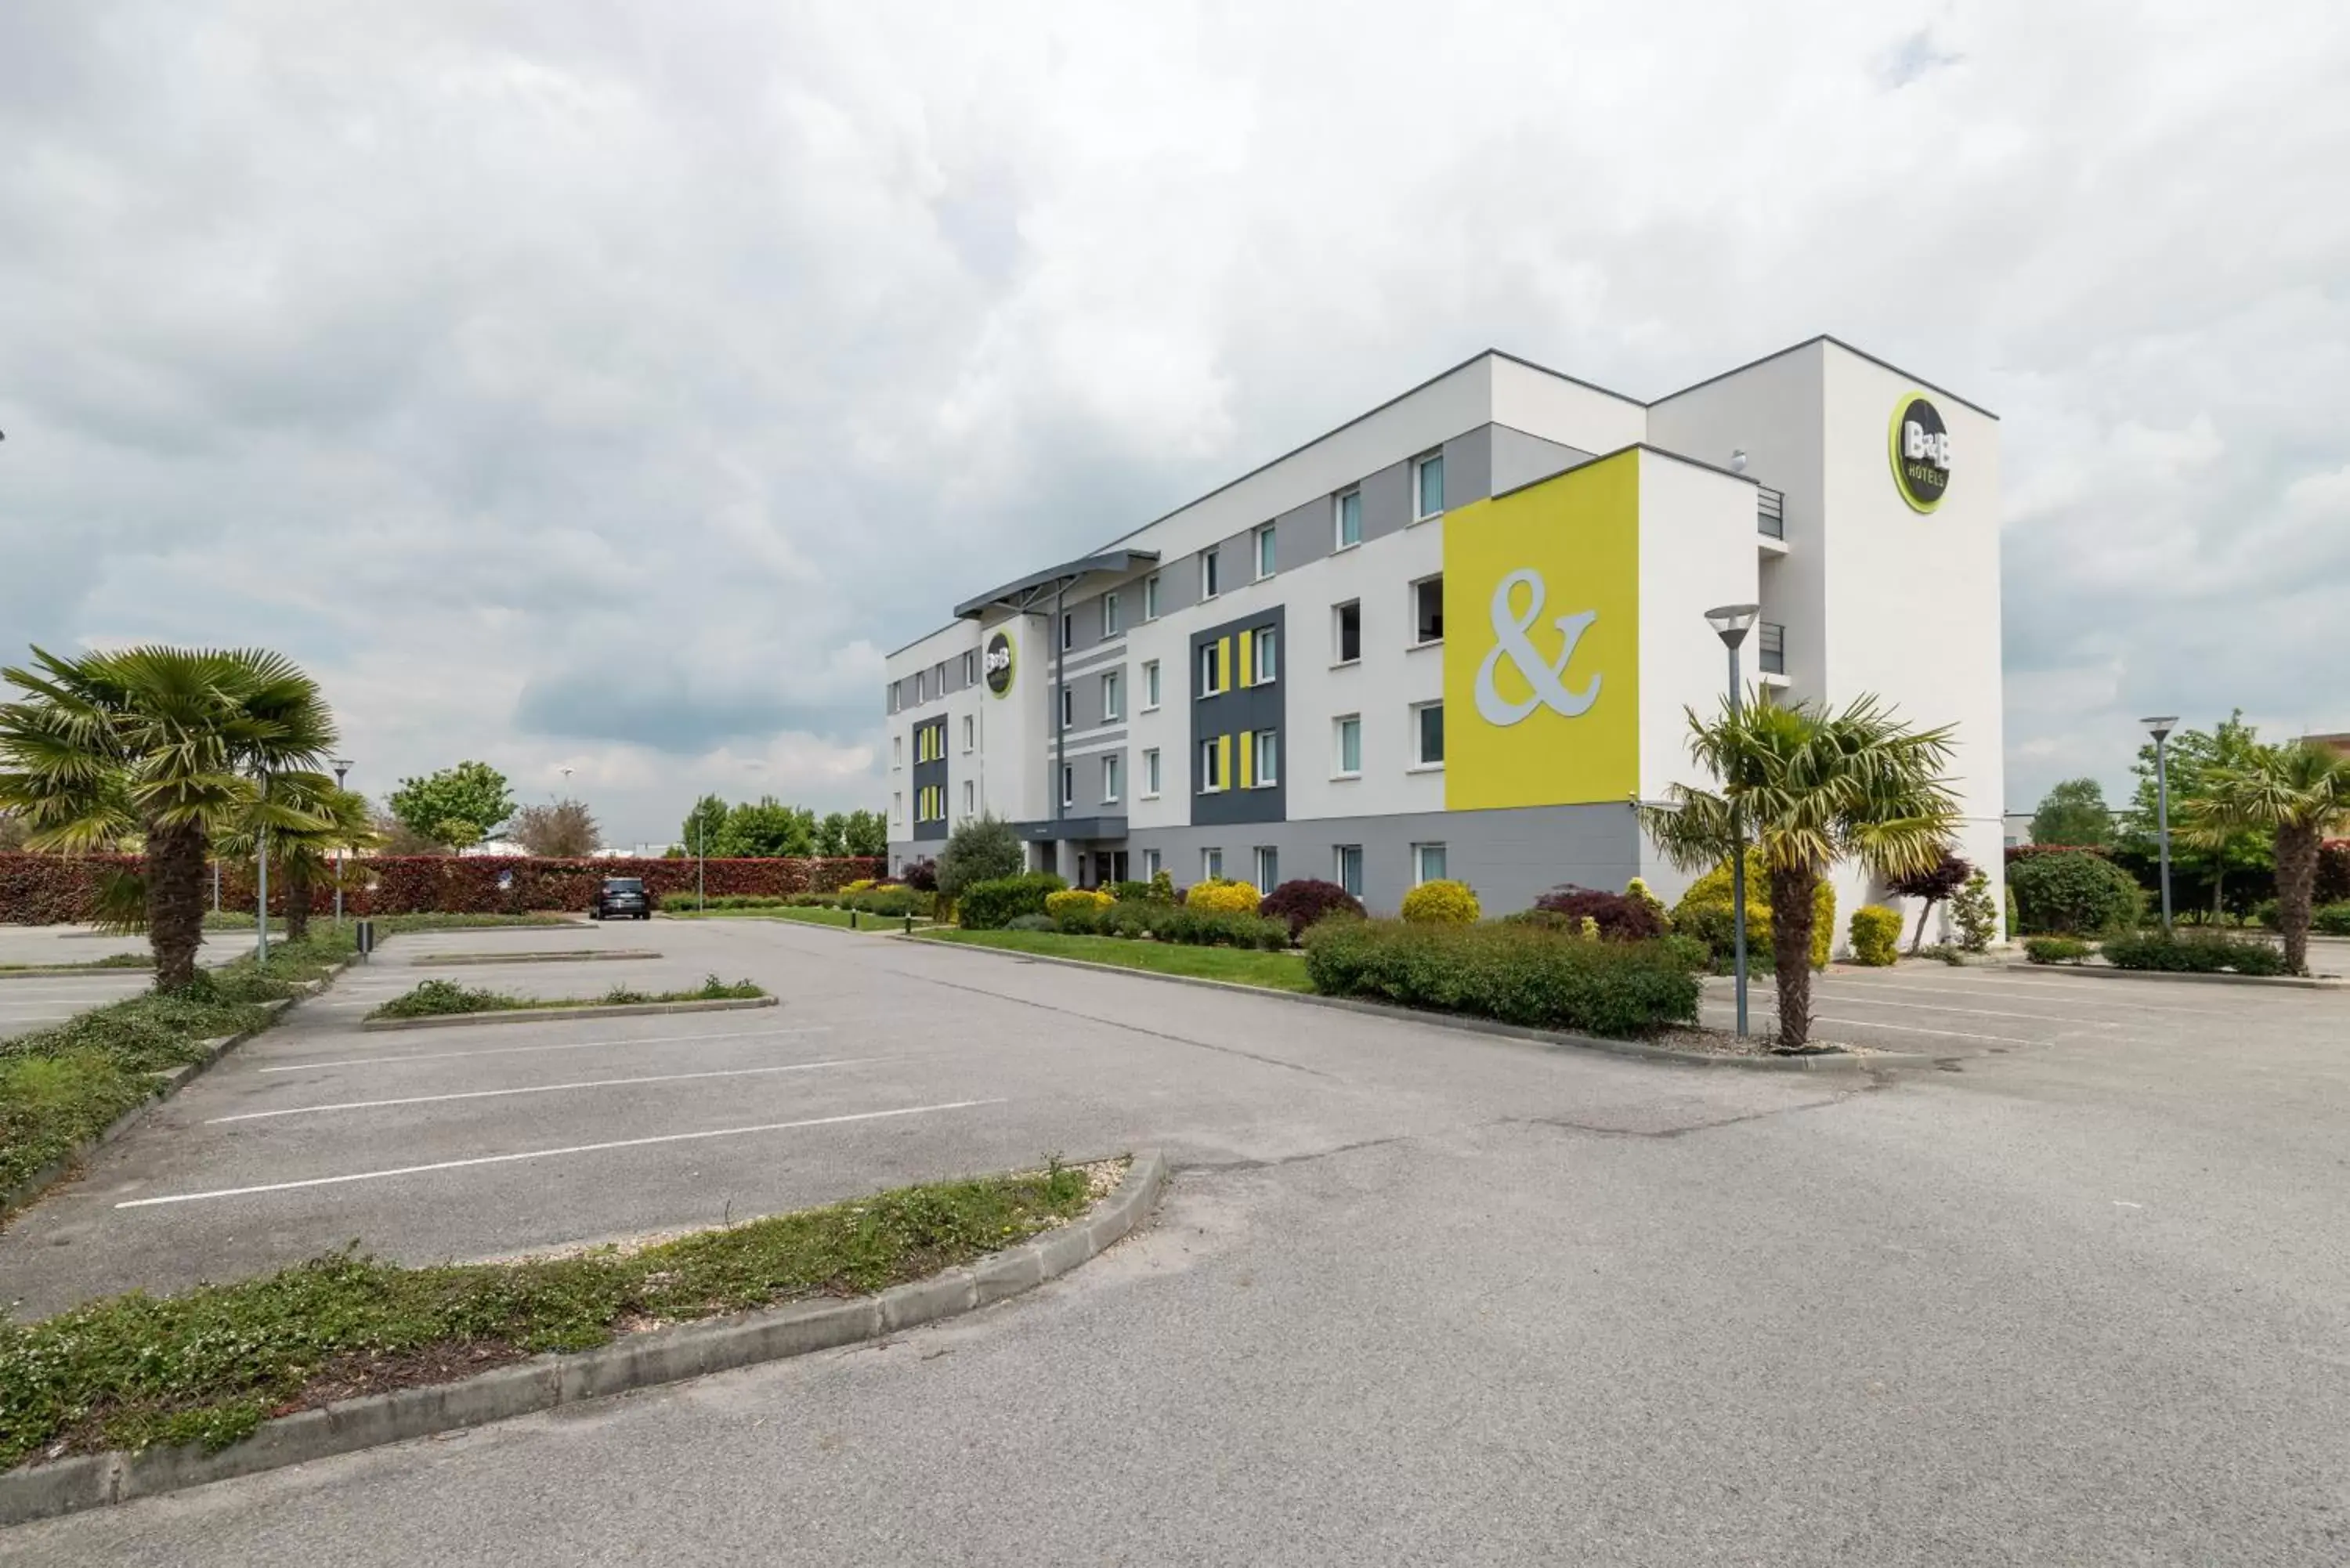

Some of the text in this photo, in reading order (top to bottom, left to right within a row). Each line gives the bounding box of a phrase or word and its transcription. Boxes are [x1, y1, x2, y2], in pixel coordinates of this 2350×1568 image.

[1904, 420, 1950, 471] B&B
[1909, 464, 1943, 487] HOTELS
[1474, 567, 1603, 727] &
